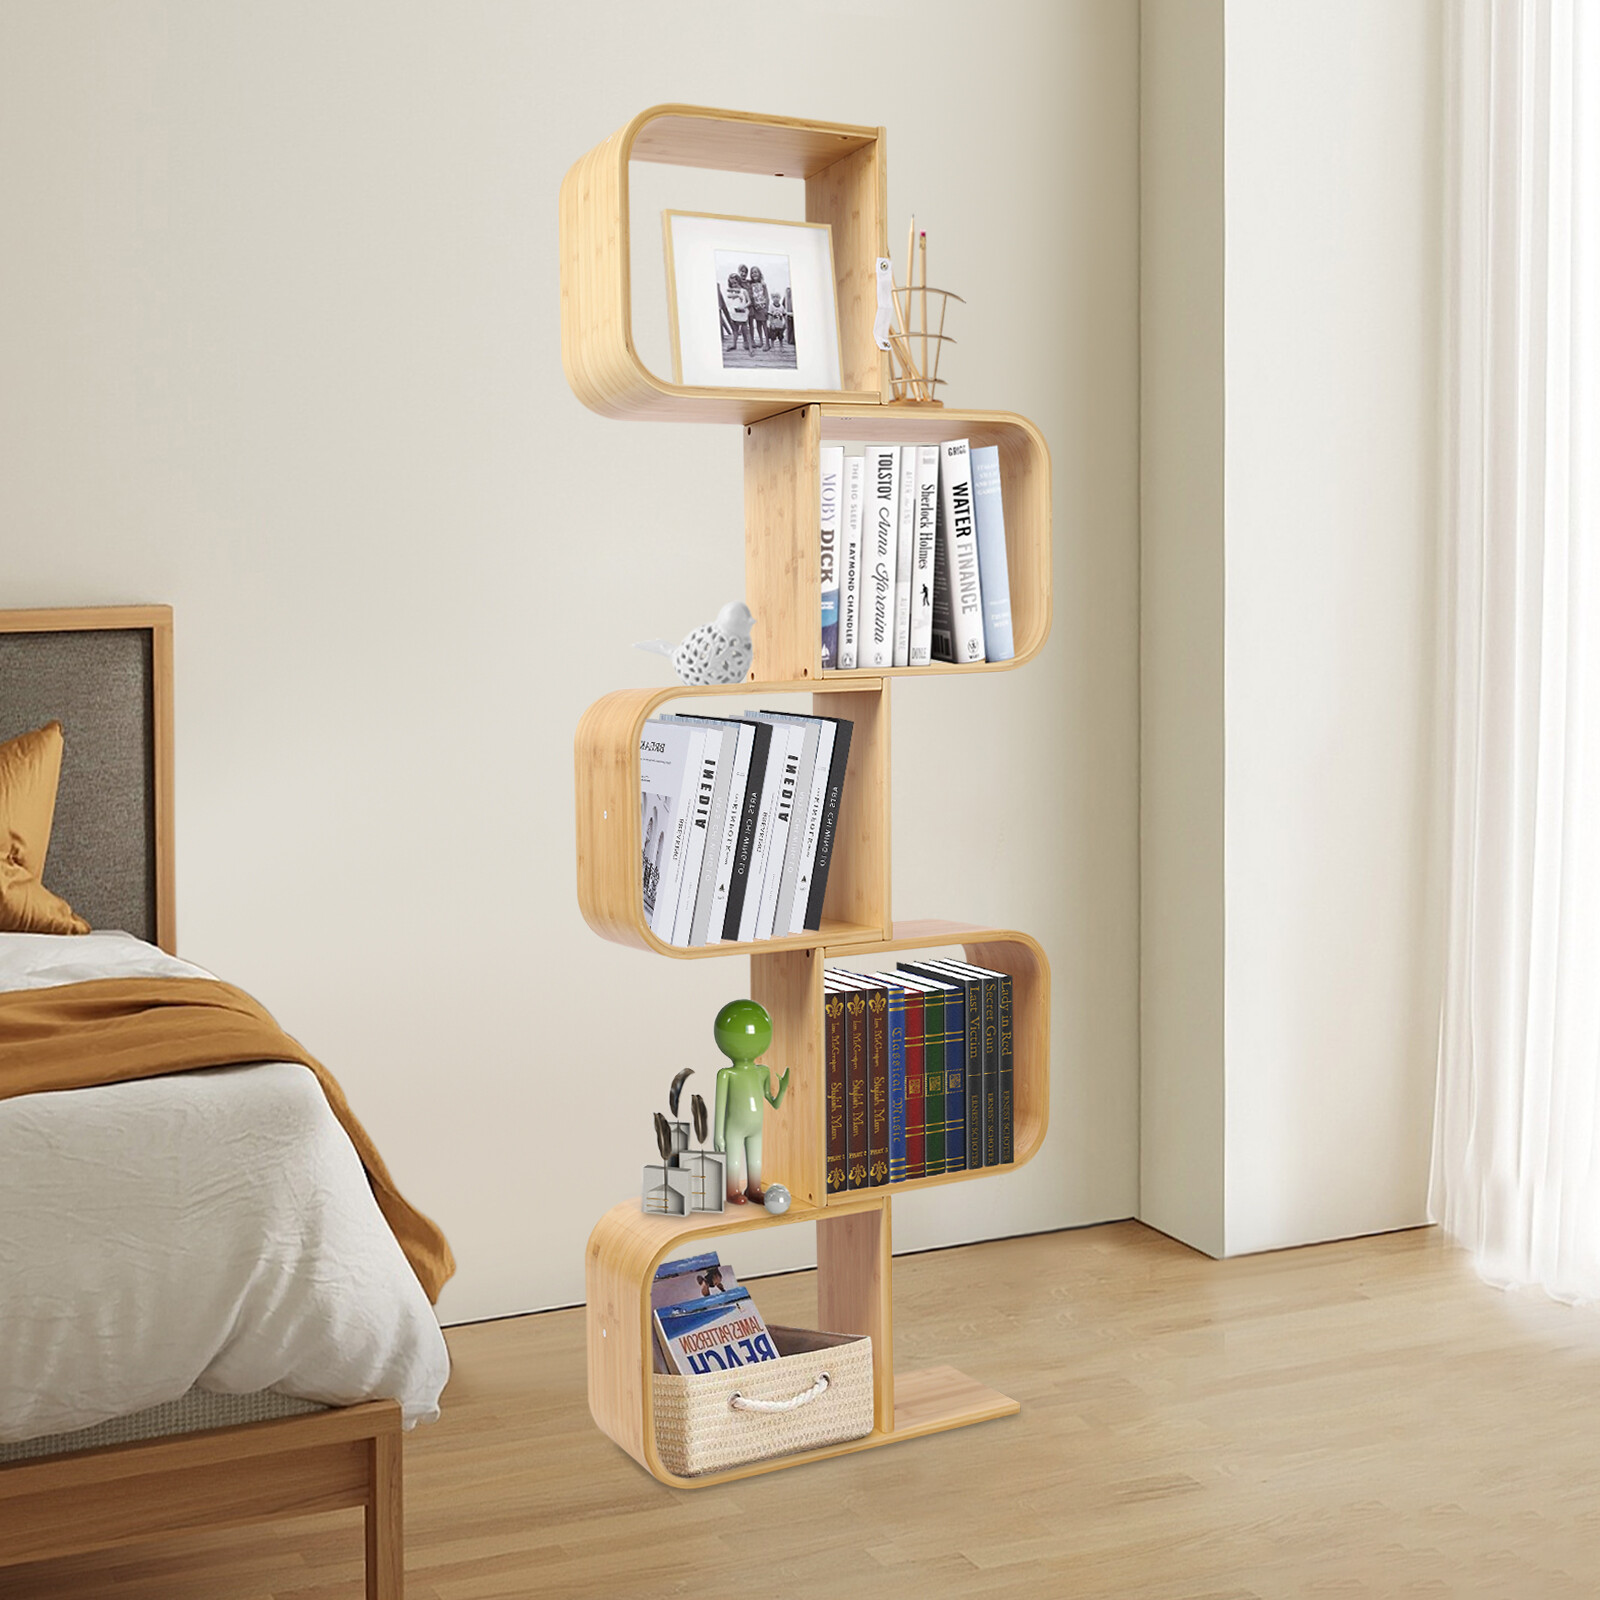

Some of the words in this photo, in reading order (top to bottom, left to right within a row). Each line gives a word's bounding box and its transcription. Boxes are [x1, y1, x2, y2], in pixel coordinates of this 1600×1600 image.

[850, 483, 858, 500] BIG
[851, 463, 859, 480] THE
[877, 453, 893, 501] TOLSTOY
[821, 473, 837, 523] MOBY
[849, 502, 857, 530] SLEEP
[919, 484, 935, 529] Sherlock
[952, 482, 972, 538] WATER
[877, 507, 892, 557] Anna
[918, 532, 933, 570] Holmes
[821, 529, 835, 584] DICK
[847, 542, 856, 593] RAYMOND
[957, 543, 978, 614] FINANCE
[845, 594, 854, 645] CHANDLER
[871, 562, 890, 644] Karenina
[969, 986, 980, 1012] Last
[985, 983, 996, 1022] Secret
[999, 980, 1012, 1011] Lady
[969, 1016, 980, 1059] Victim
[985, 1025, 996, 1054] Gun
[1001, 1015, 1011, 1027] in
[891, 1026, 903, 1092] Classical
[1001, 1031, 1012, 1057] Red
[892, 1096, 903, 1143] Music
[970, 1094, 979, 1127] ERNEST
[986, 1092, 994, 1123] ERNEST
[1002, 1090, 1010, 1122] ERNEST
